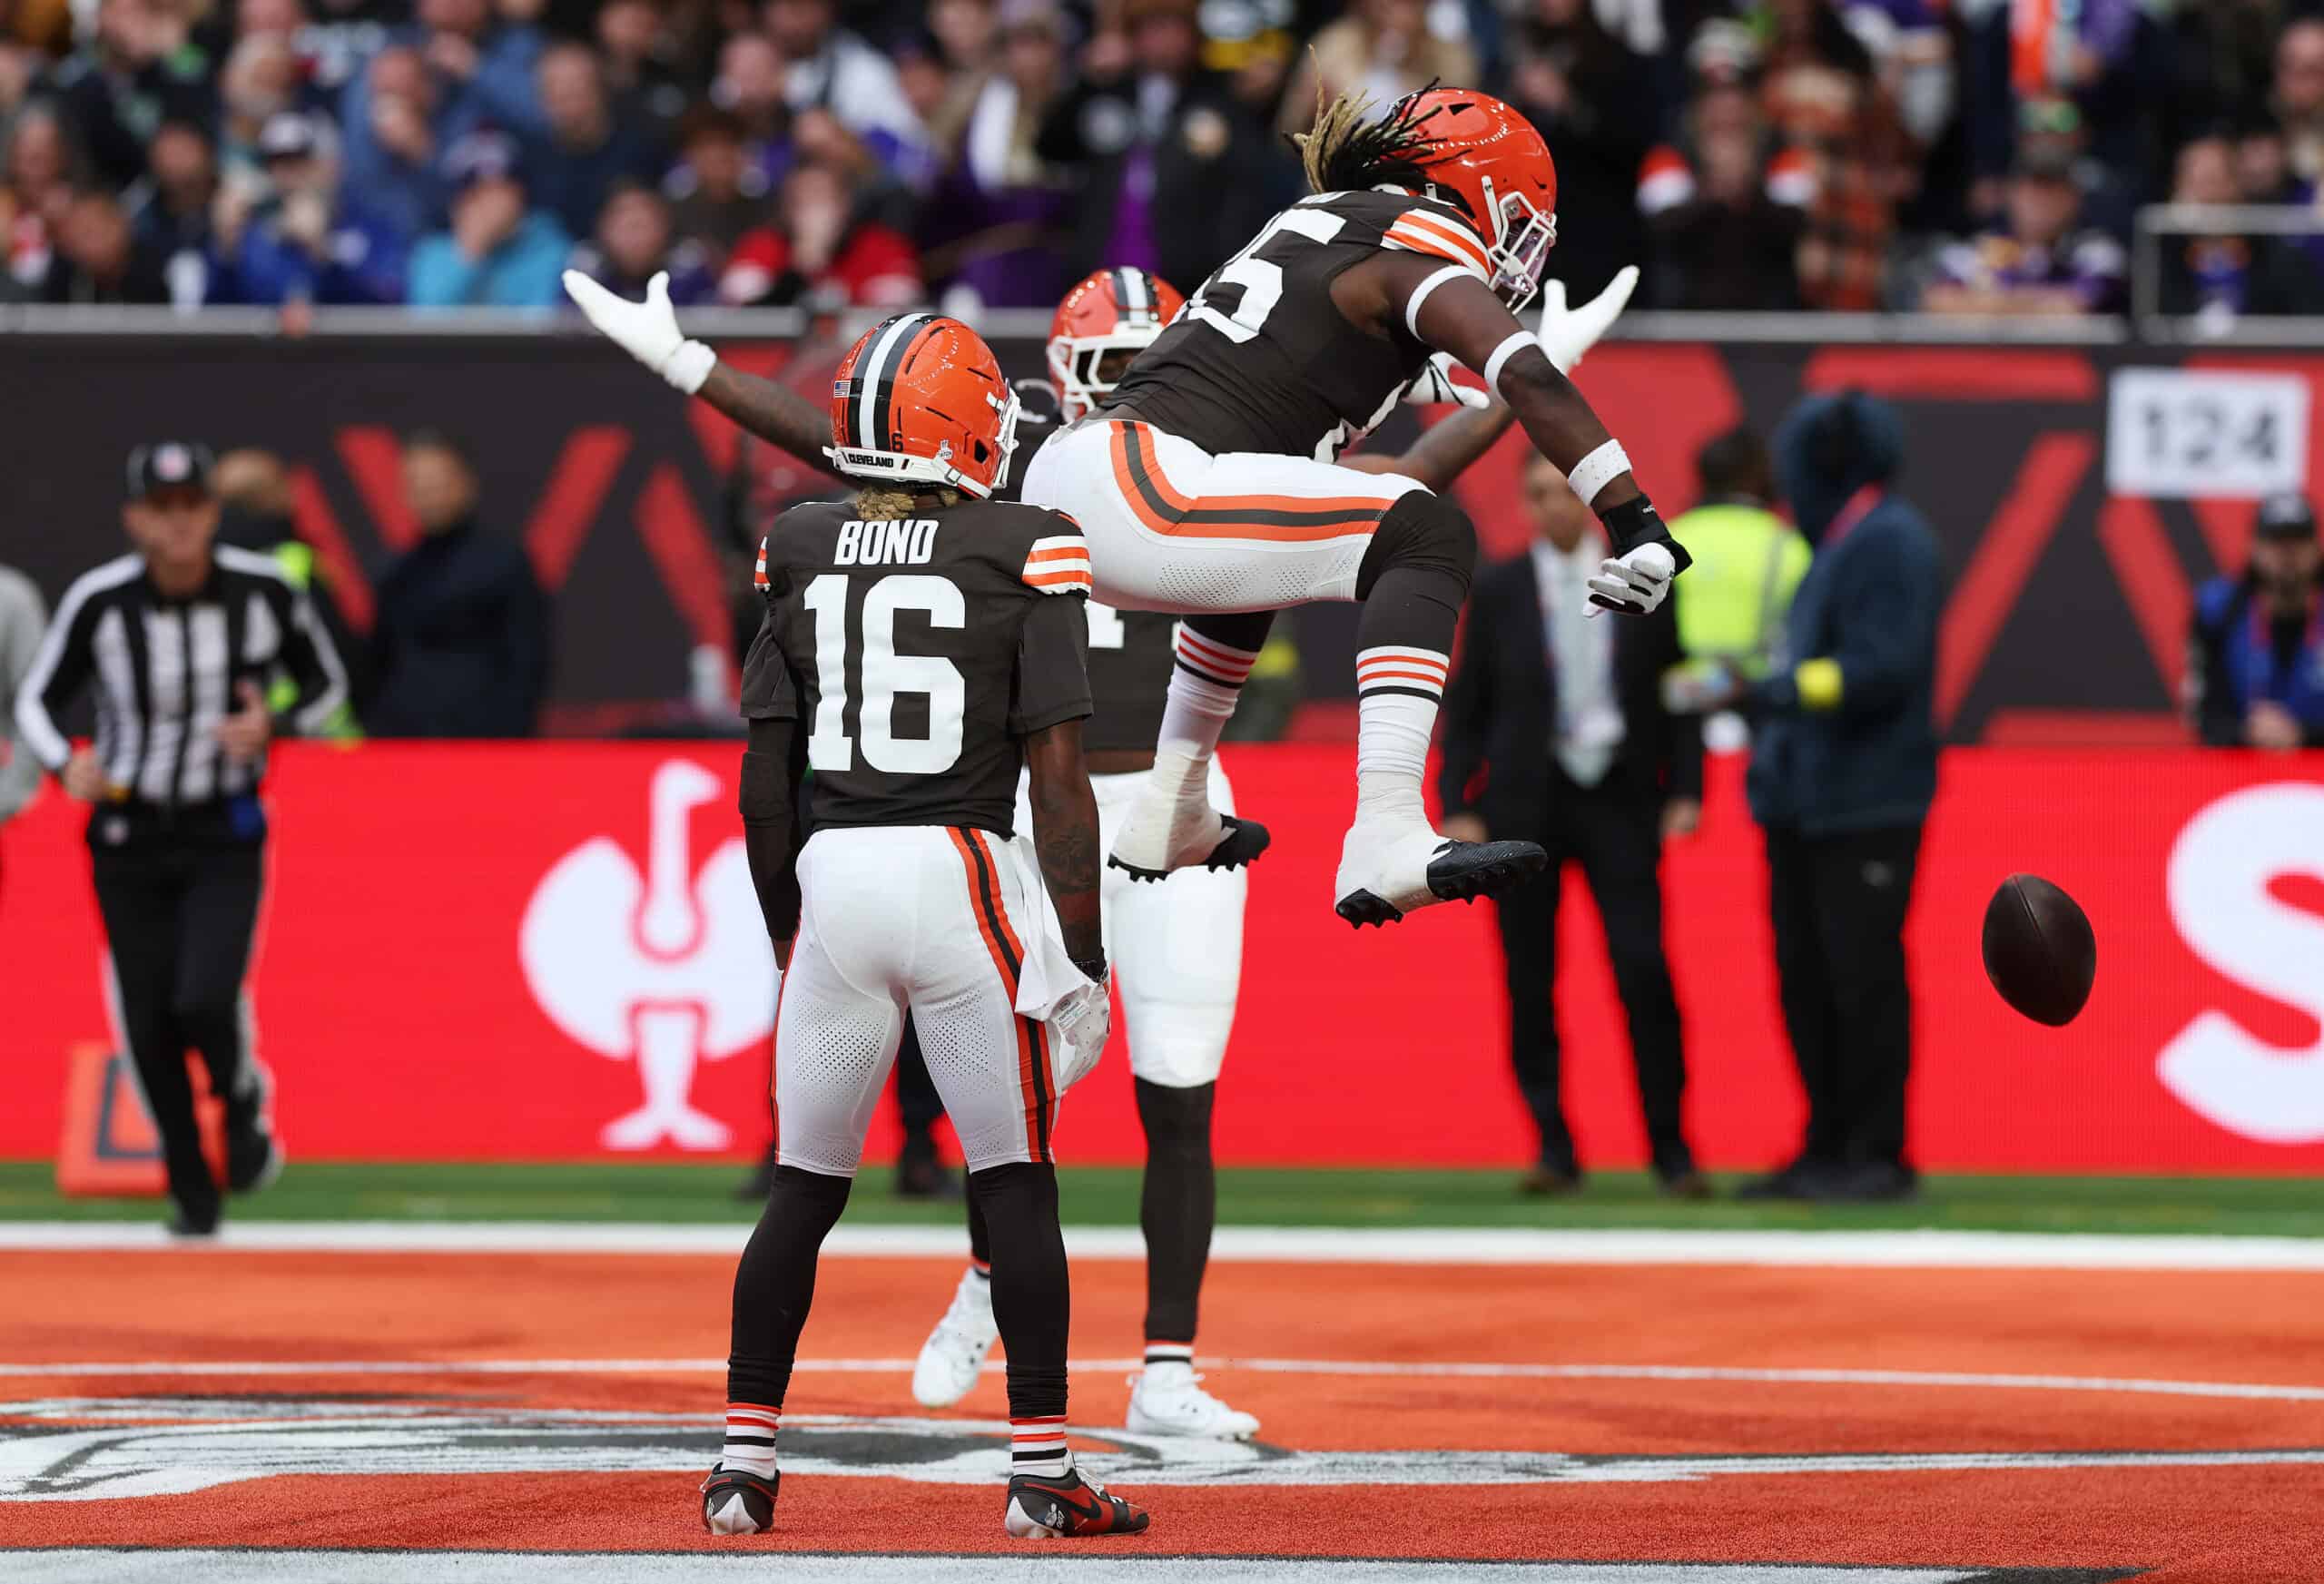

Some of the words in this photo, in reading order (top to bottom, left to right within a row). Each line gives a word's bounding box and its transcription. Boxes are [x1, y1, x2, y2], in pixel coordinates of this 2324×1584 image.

[1166, 208, 1347, 344] 5
[848, 453, 894, 468] CLEVELAND
[2142, 400, 2278, 466] 124
[833, 519, 939, 566] BOND
[804, 574, 965, 774] 16
